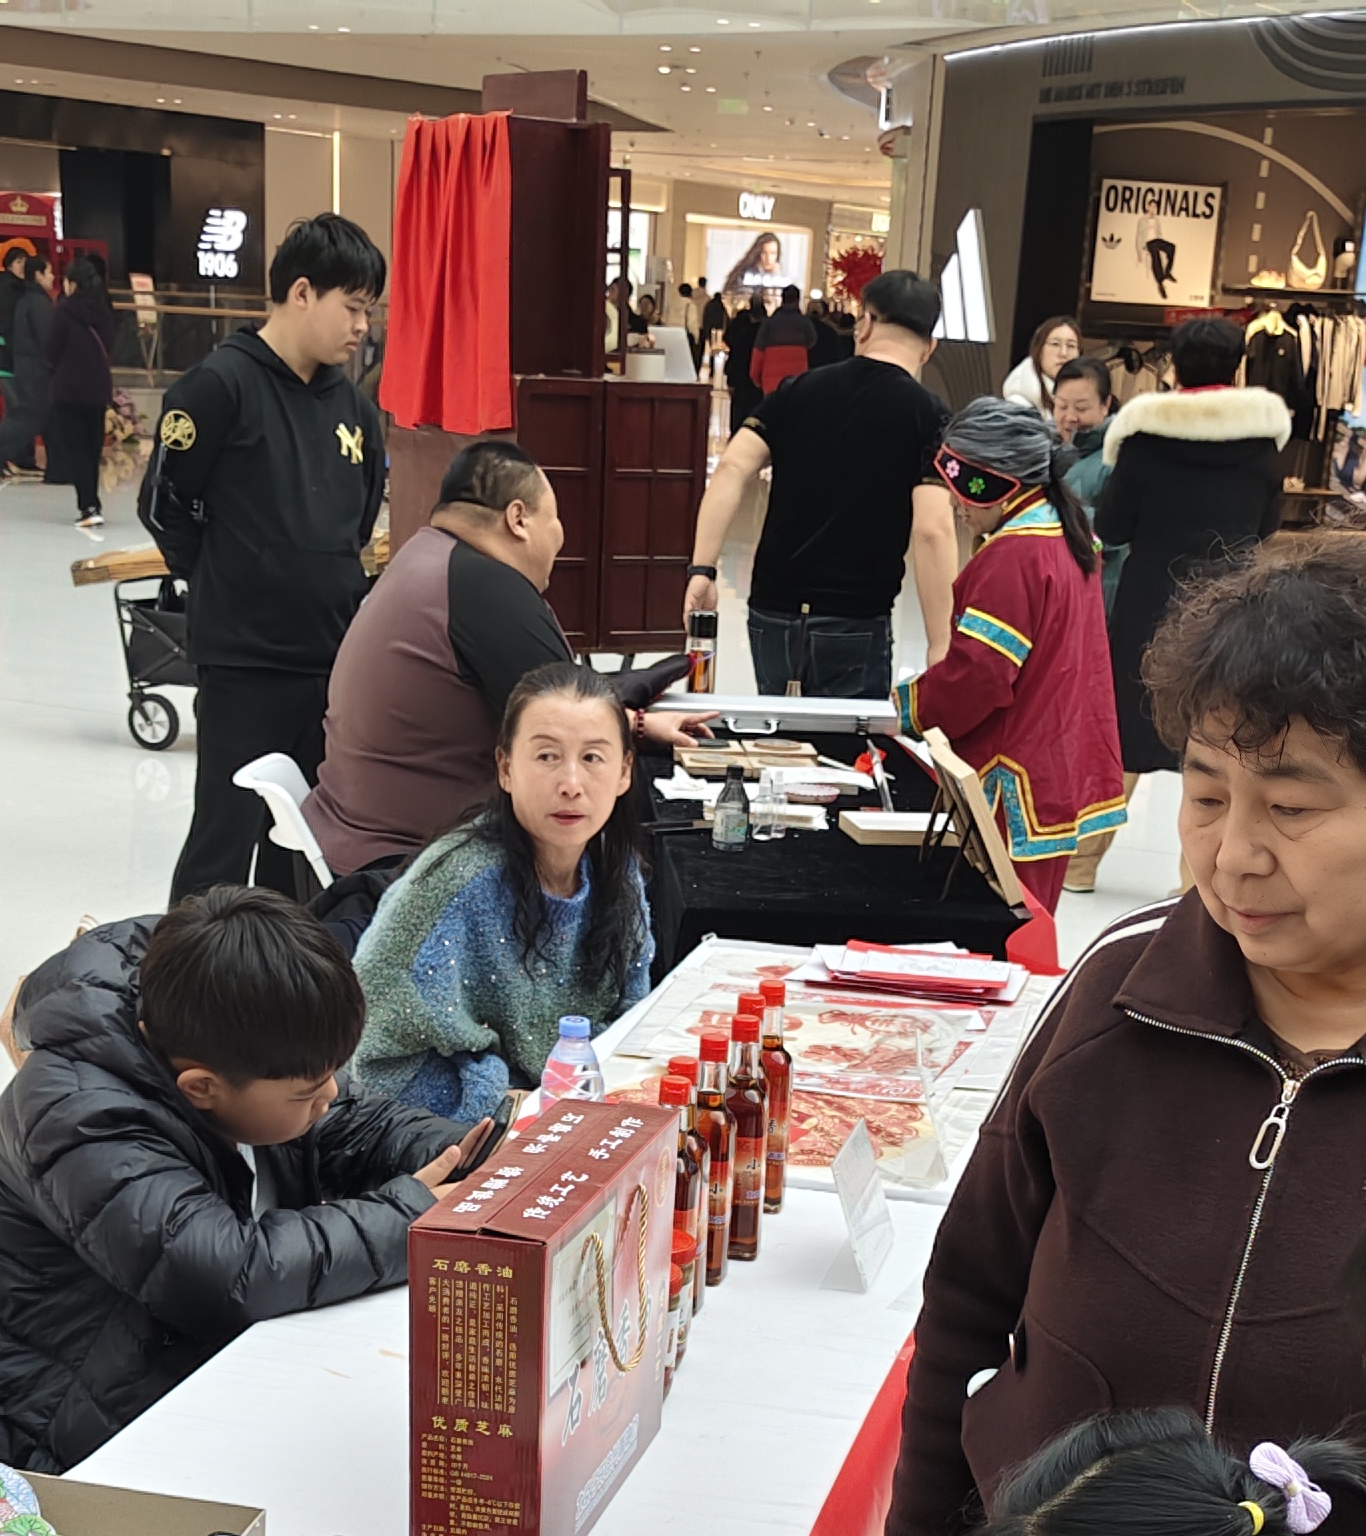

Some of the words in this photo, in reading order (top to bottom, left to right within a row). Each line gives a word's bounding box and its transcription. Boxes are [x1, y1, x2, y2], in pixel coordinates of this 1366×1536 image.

[739, 192, 775, 220] ONLY
[1105, 185, 1214, 220] ORIGINALS
[197, 251, 238, 278] 1906
[522, 1170, 589, 1220] 传统工艺
[588, 1116, 644, 1160] 手工制作
[431, 1258, 514, 1279] 石磨香油
[431, 1415, 514, 1438] 优质芝麻
